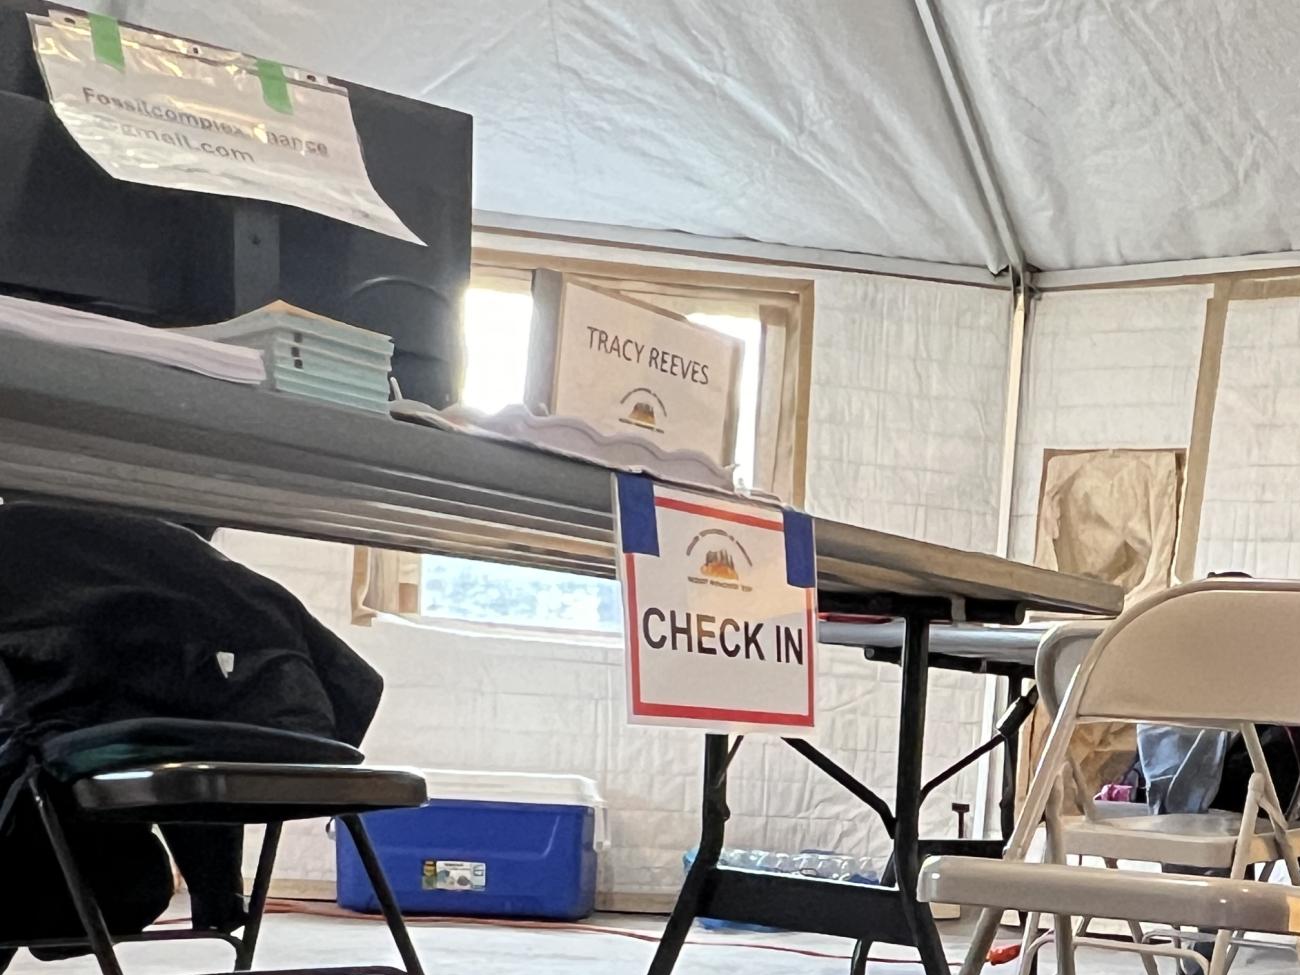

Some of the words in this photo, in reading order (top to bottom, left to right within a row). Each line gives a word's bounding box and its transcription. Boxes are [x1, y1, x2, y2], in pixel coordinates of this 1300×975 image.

[587, 326, 645, 363] TRACY
[648, 347, 709, 385] REEVES
[642, 607, 766, 661] CHECK
[775, 624, 804, 665] IN
